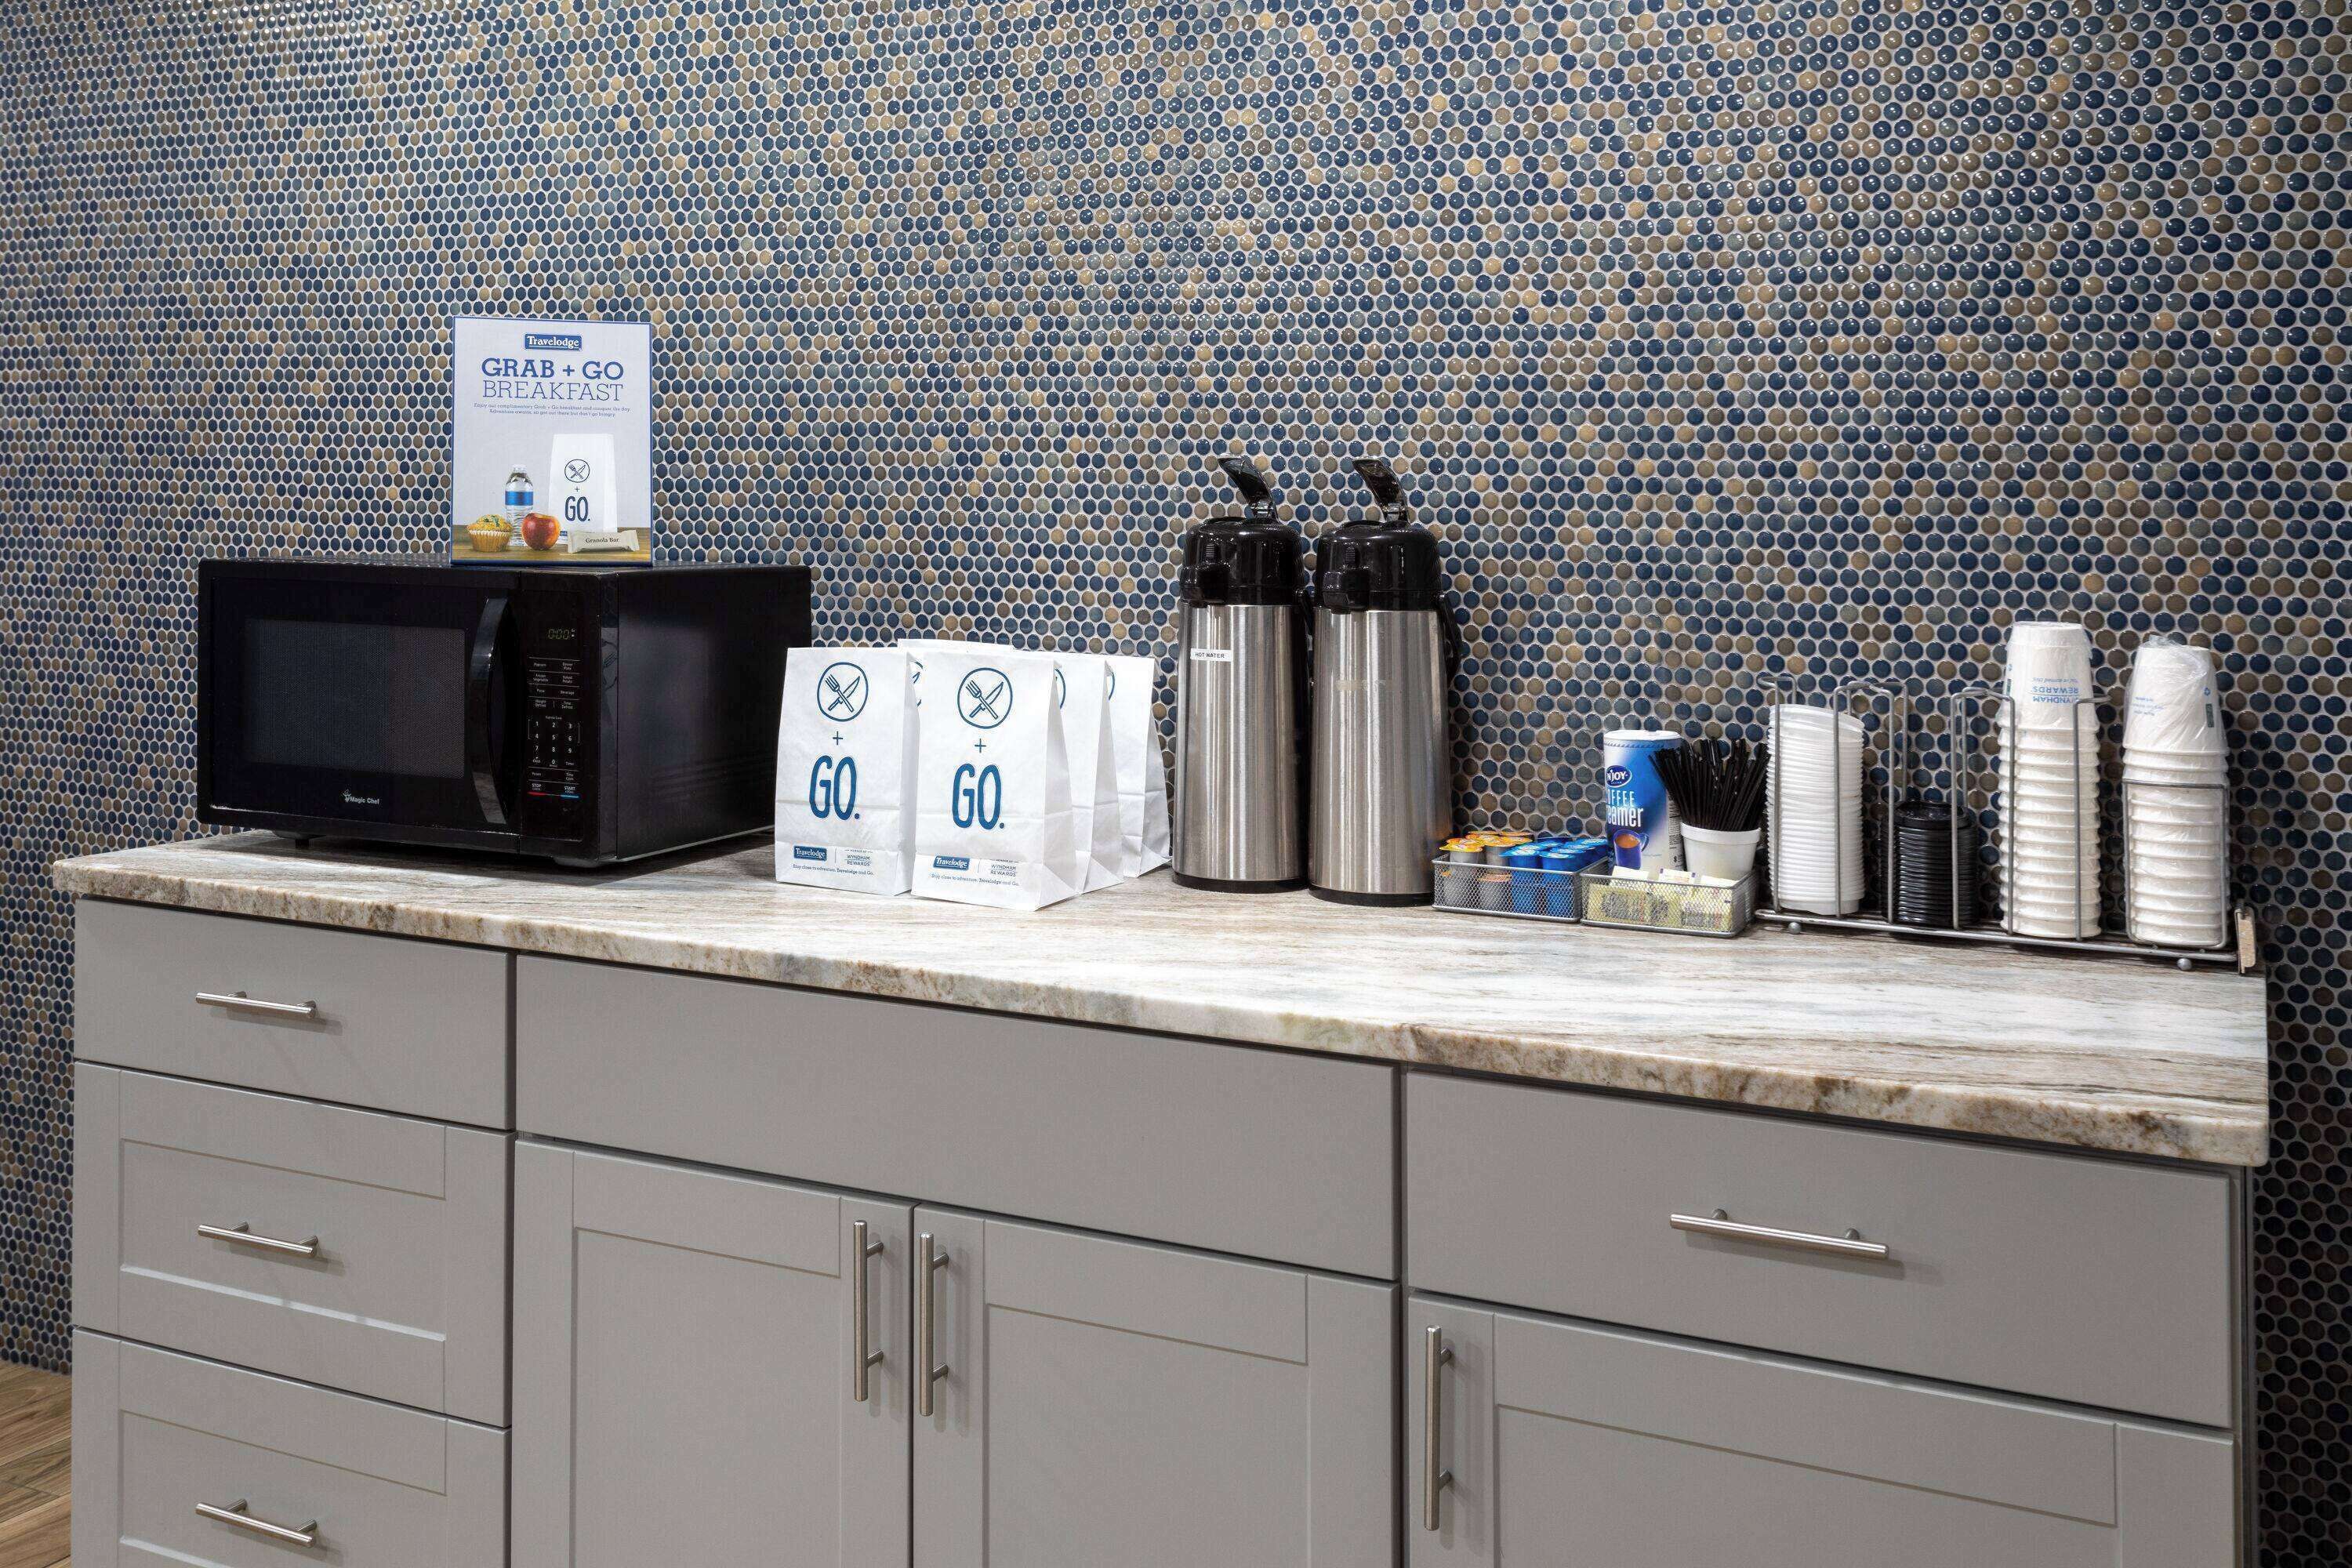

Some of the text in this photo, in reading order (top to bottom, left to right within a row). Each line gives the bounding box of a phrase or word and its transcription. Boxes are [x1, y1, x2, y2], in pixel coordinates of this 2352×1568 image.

[527, 336, 579, 349] Travelodge
[481, 358, 624, 380] GRAB + GO
[482, 379, 623, 401] BREAKFAST
[564, 495, 591, 522] GO.
[809, 754, 860, 821] GO.
[952, 763, 1005, 830] GO.
[350, 796, 365, 804] Magic
[1606, 804, 1644, 827] eamer
[795, 848, 826, 859] Travelodge
[936, 856, 967, 869] Travelodge
